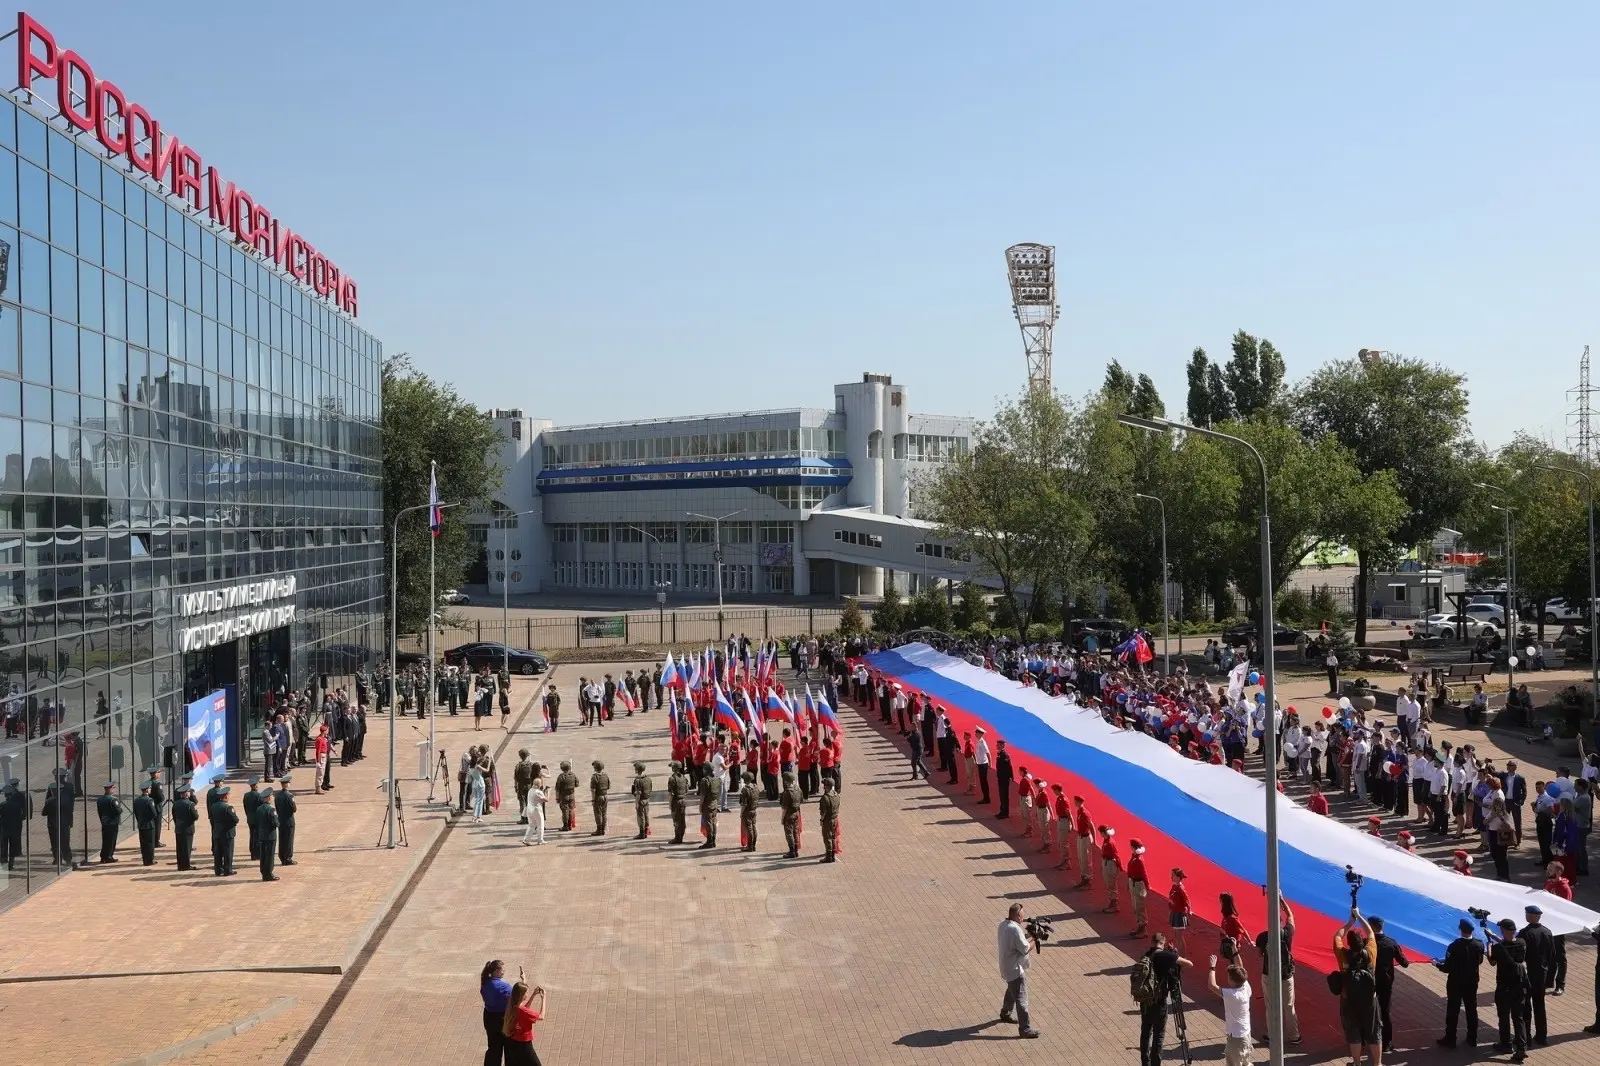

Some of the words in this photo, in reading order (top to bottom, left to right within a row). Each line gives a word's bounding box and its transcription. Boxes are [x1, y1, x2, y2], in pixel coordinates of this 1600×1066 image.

[17, 11, 202, 211] РОССИЯ
[207, 165, 271, 259] МОЯ
[272, 218, 358, 318] ИСТОРИЯ
[182, 575, 297, 618] МУЛЬТИМЕДИЙНЫЙ
[179, 608, 272, 653] ИСТОРИЧЕСКИЙ
[271, 604, 297, 628] ПАРК
